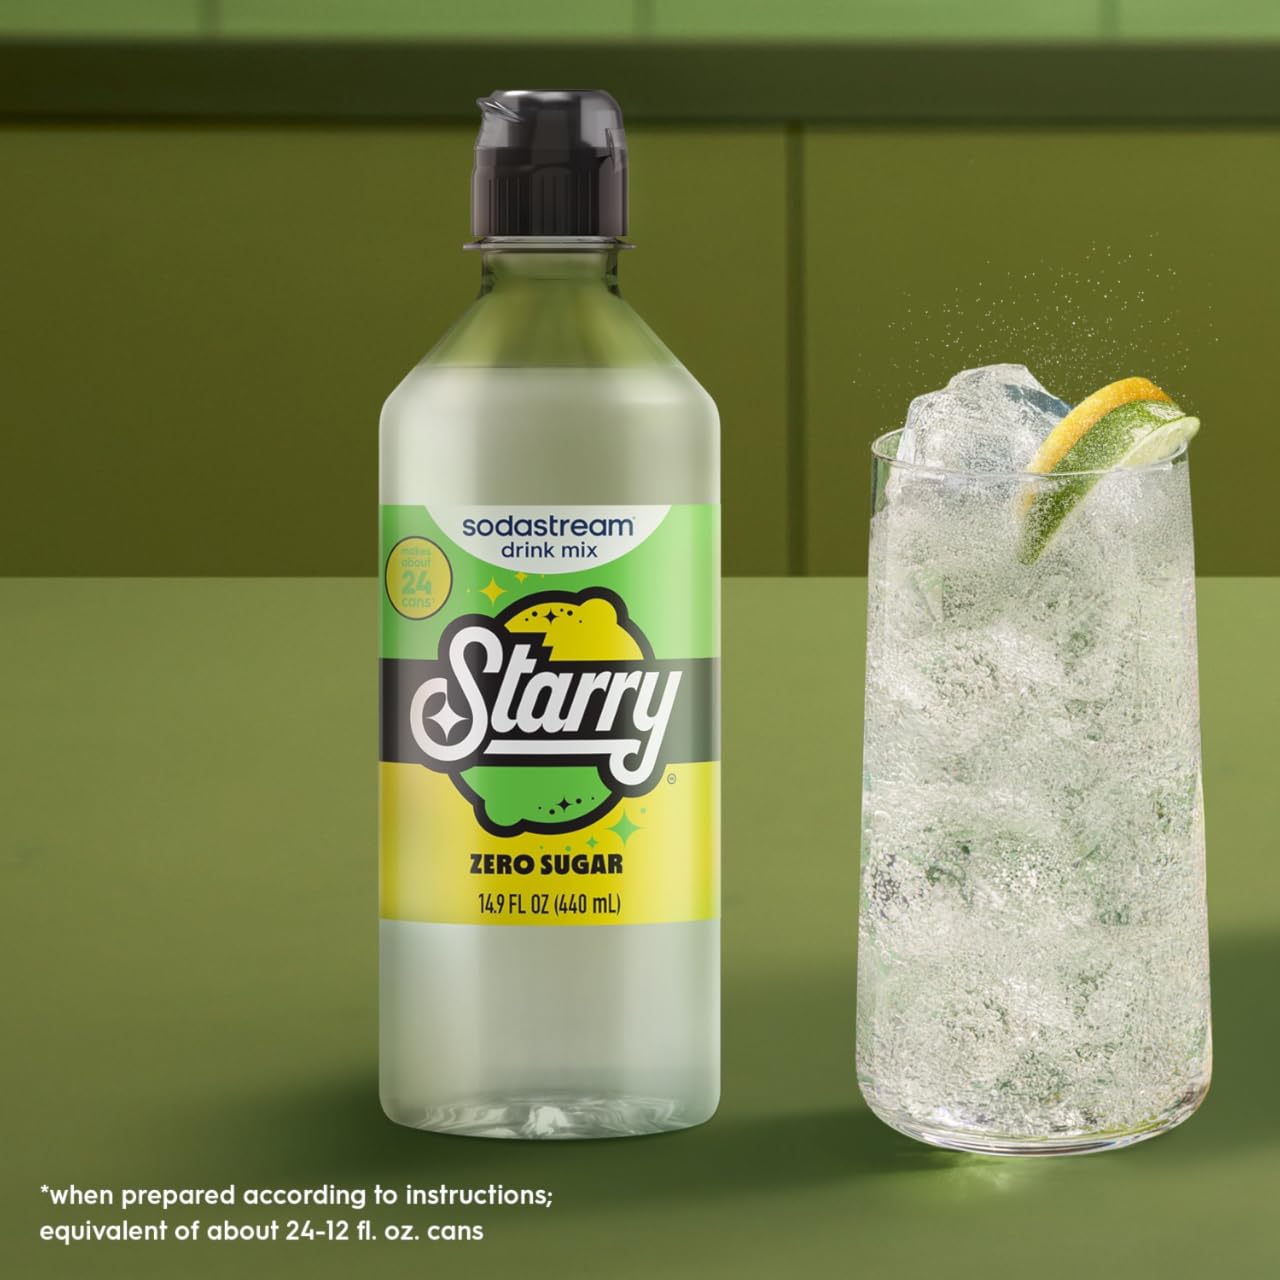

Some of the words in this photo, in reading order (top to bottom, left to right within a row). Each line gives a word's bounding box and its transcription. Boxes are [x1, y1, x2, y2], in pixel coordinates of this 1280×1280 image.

[462, 515, 635, 537] sodastream
[501, 542, 555, 559] drink
[561, 543, 599, 559] mix
[401, 570, 432, 594] 24
[410, 626, 683, 786] Starry
[470, 854, 535, 874] ZERO
[540, 853, 623, 875] SUGAR
[478, 893, 505, 914] 14.9
[509, 894, 527, 914] FL
[531, 894, 549, 914] OZ
[554, 893, 587, 915] (440
[592, 893, 621, 915] mL)
